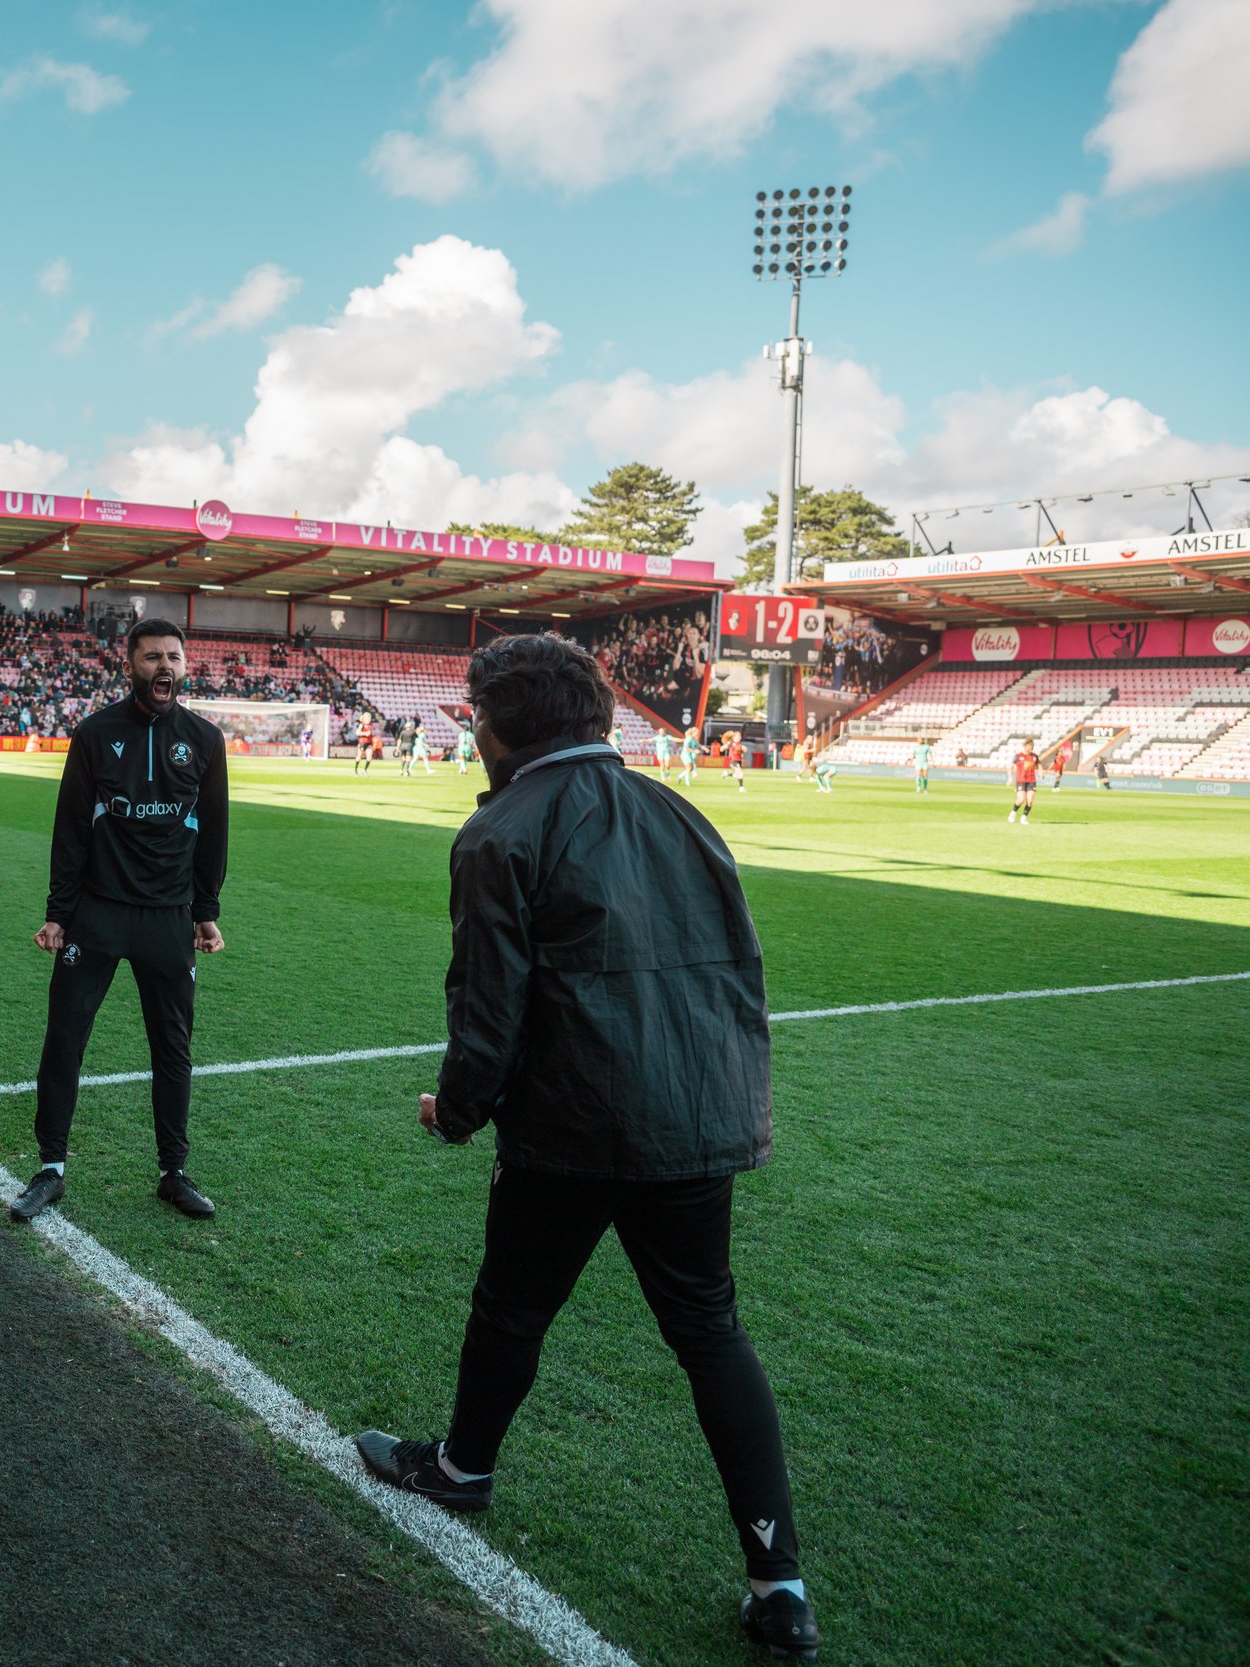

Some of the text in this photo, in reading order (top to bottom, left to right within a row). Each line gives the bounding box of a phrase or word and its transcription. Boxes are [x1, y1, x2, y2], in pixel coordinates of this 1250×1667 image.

[96, 507, 127, 515] FLETCHER
[199, 508, 232, 531] Vitality
[295, 525, 322, 534] FLETCHER
[359, 526, 622, 570] VITALITY STADIUM
[1168, 533, 1246, 555] AMSTEL
[1026, 547, 1090, 566] AMSTEL
[849, 566, 885, 579] utilita
[928, 560, 967, 574] utilita
[975, 634, 1018, 652] Vitality
[1214, 628, 1248, 645] Vitality
[136, 800, 182, 819] galaxy
